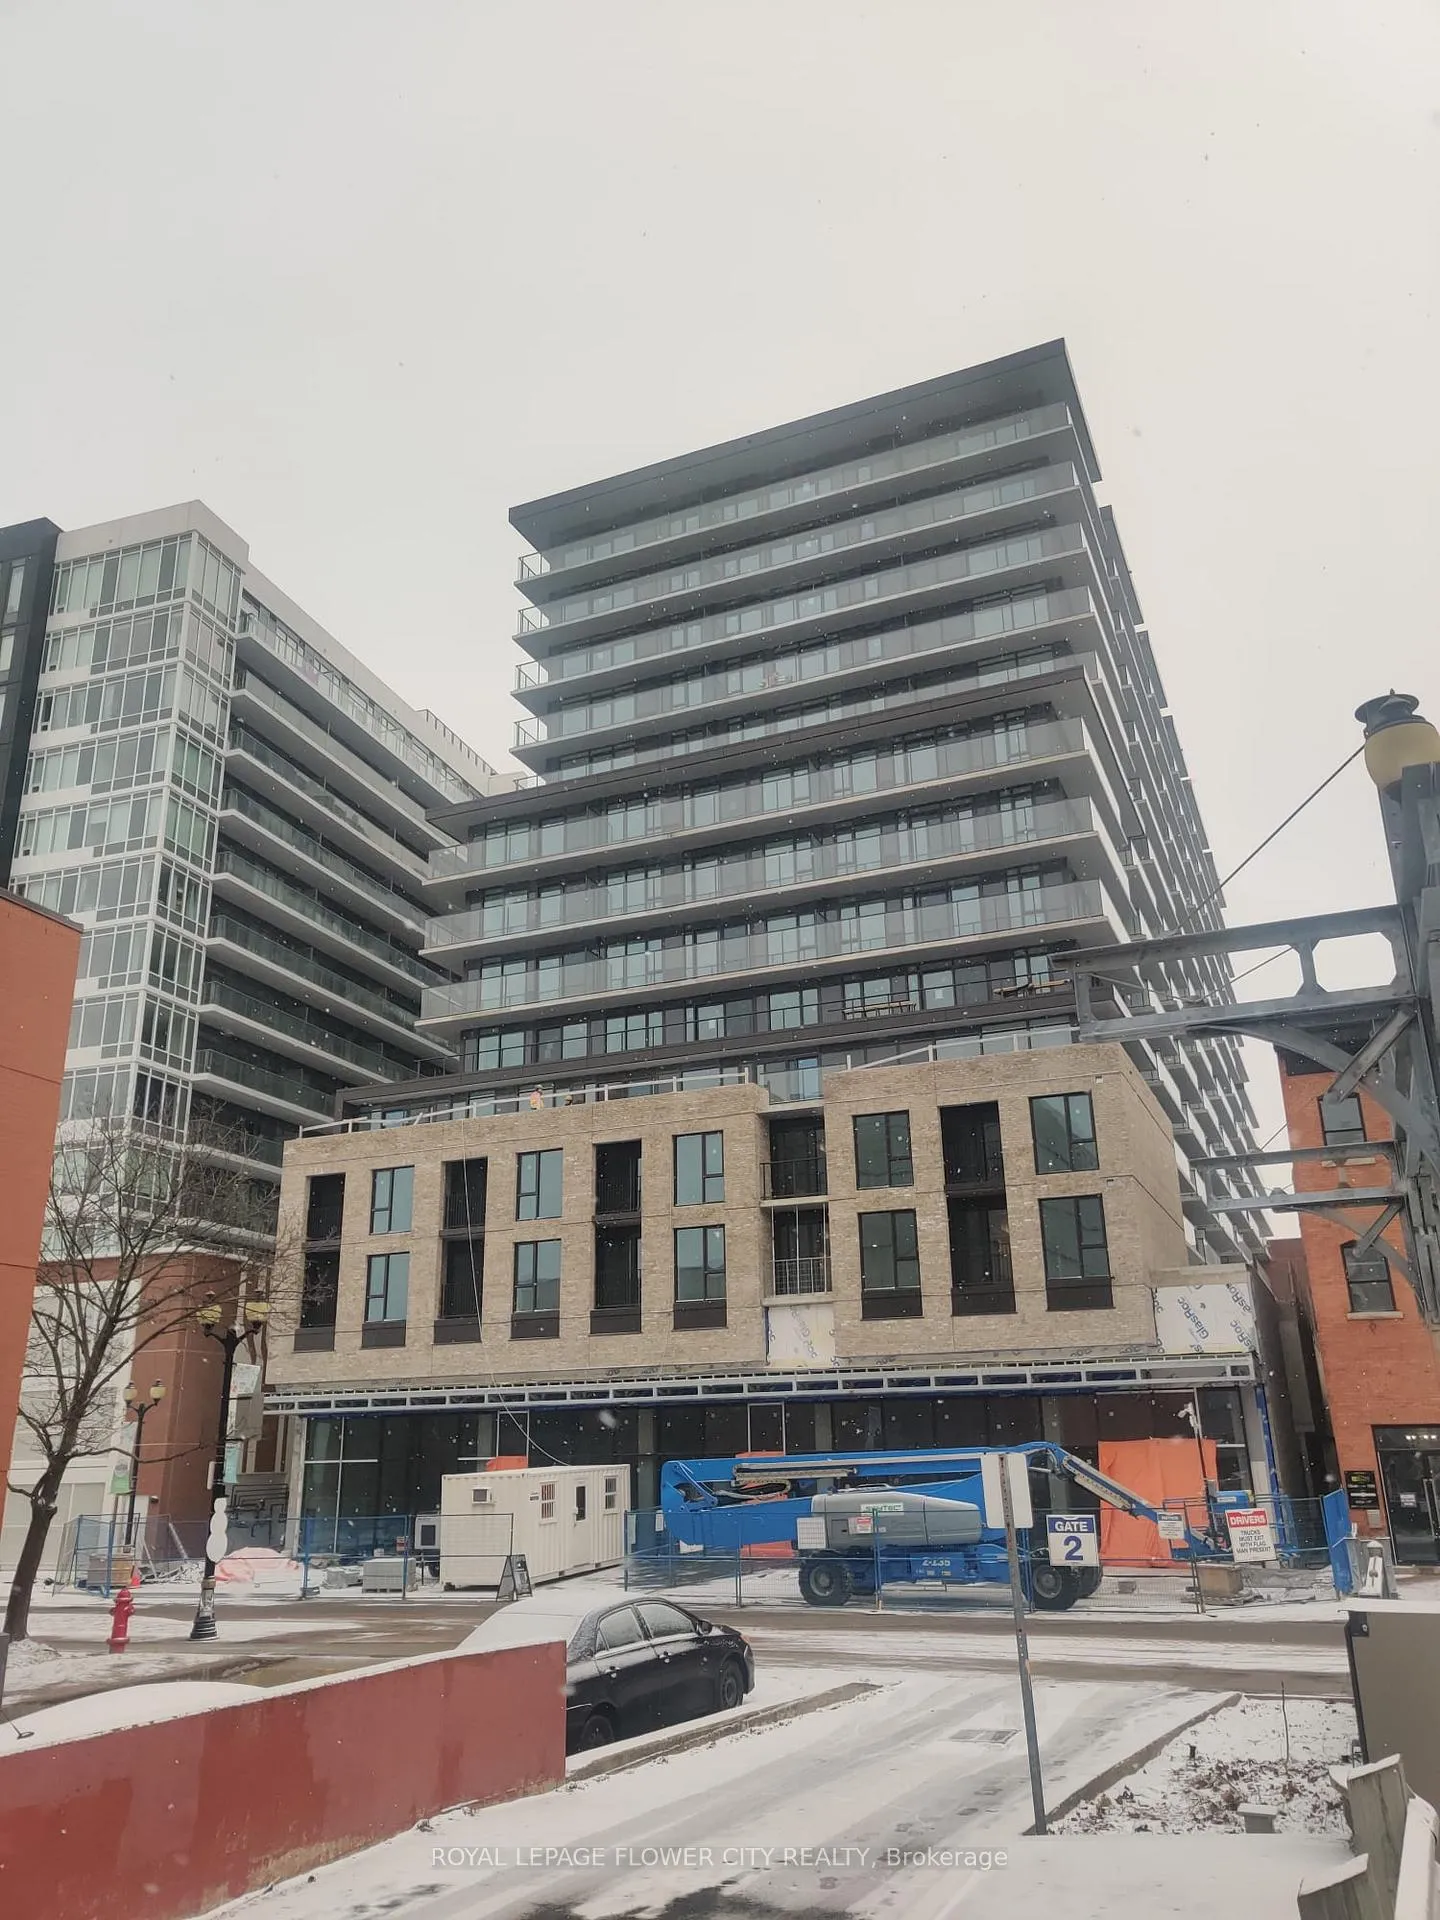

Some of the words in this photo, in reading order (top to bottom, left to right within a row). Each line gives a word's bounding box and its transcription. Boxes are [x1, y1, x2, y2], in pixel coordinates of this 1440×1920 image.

[1177, 1296, 1209, 1339] GlasRoc
[1055, 1521, 1088, 1532] GATE
[1230, 1514, 1266, 1525] DRIVERS
[1063, 1535, 1084, 1561] 2
